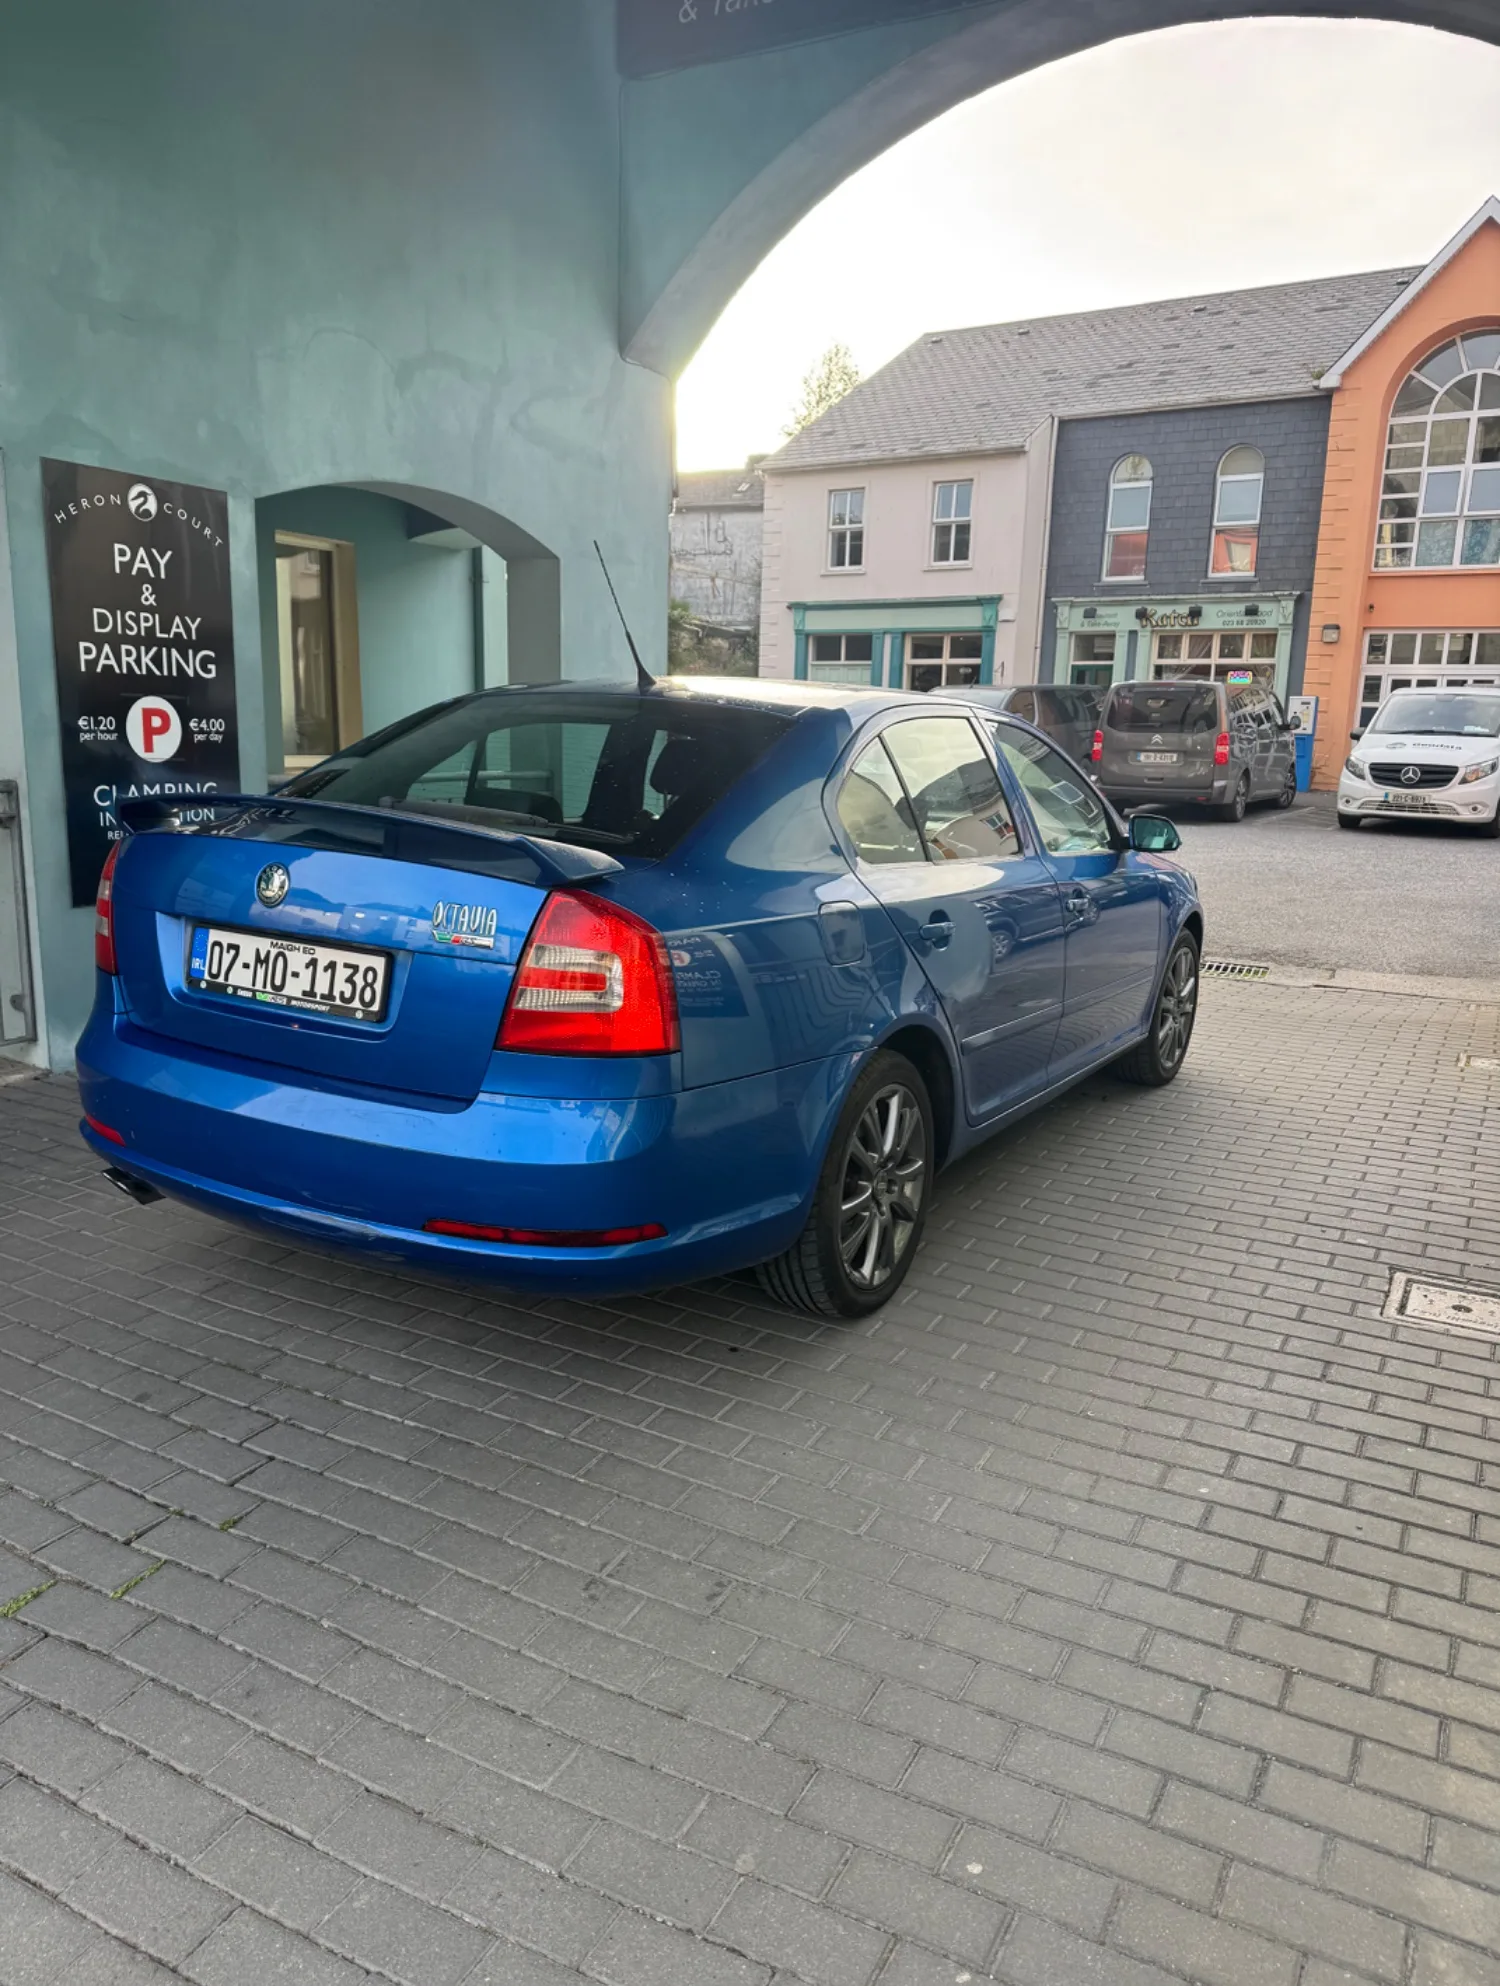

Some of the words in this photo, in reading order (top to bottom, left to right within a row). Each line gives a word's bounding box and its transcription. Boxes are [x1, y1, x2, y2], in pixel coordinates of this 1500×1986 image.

[54, 493, 122, 524] HERON
[163, 502, 224, 547] COURT
[113, 543, 173, 579] PAY
[140, 583, 157, 606] &
[92, 607, 202, 640] DISPLAY
[78, 641, 217, 679] PARKING
[78, 715, 116, 730] €1.20
[141, 707, 172, 753] P
[189, 718, 225, 732] €4.00
[79, 732, 95, 743] per
[97, 731, 118, 741] hour
[193, 734, 207, 744] per
[208, 733, 223, 743] day
[433, 900, 497, 936] OCTAVIA
[191, 956, 206, 971] IRL
[302, 946, 316, 955] EO
[207, 940, 378, 1008] 07-MO-1138
